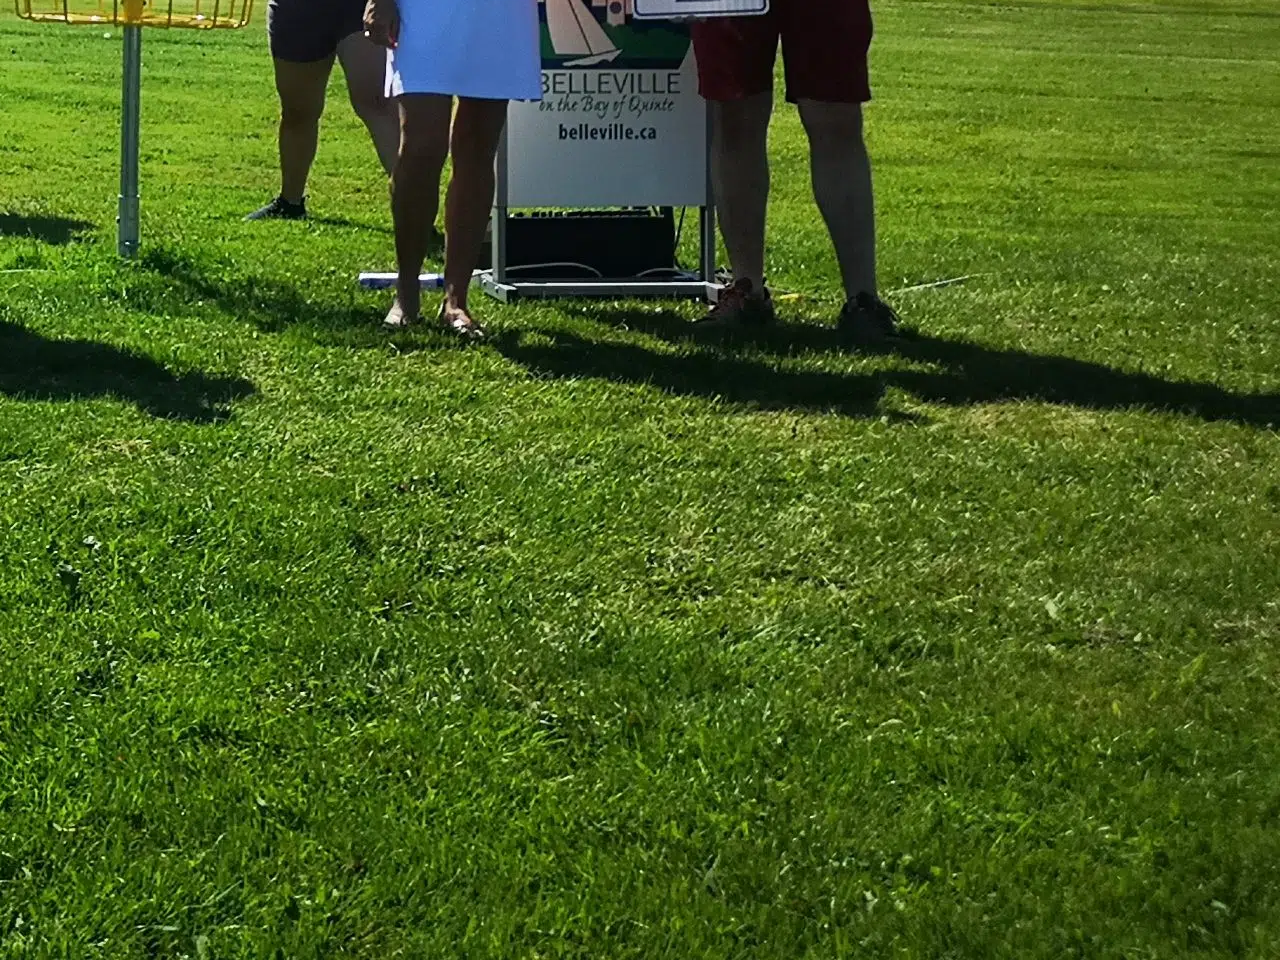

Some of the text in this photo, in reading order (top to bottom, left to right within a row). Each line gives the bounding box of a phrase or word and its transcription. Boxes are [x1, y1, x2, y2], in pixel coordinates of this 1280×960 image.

[541, 73, 680, 94] BELLEVILLE
[539, 93, 675, 119] on the Bay of Quinte
[558, 123, 657, 140] belleville.ca
